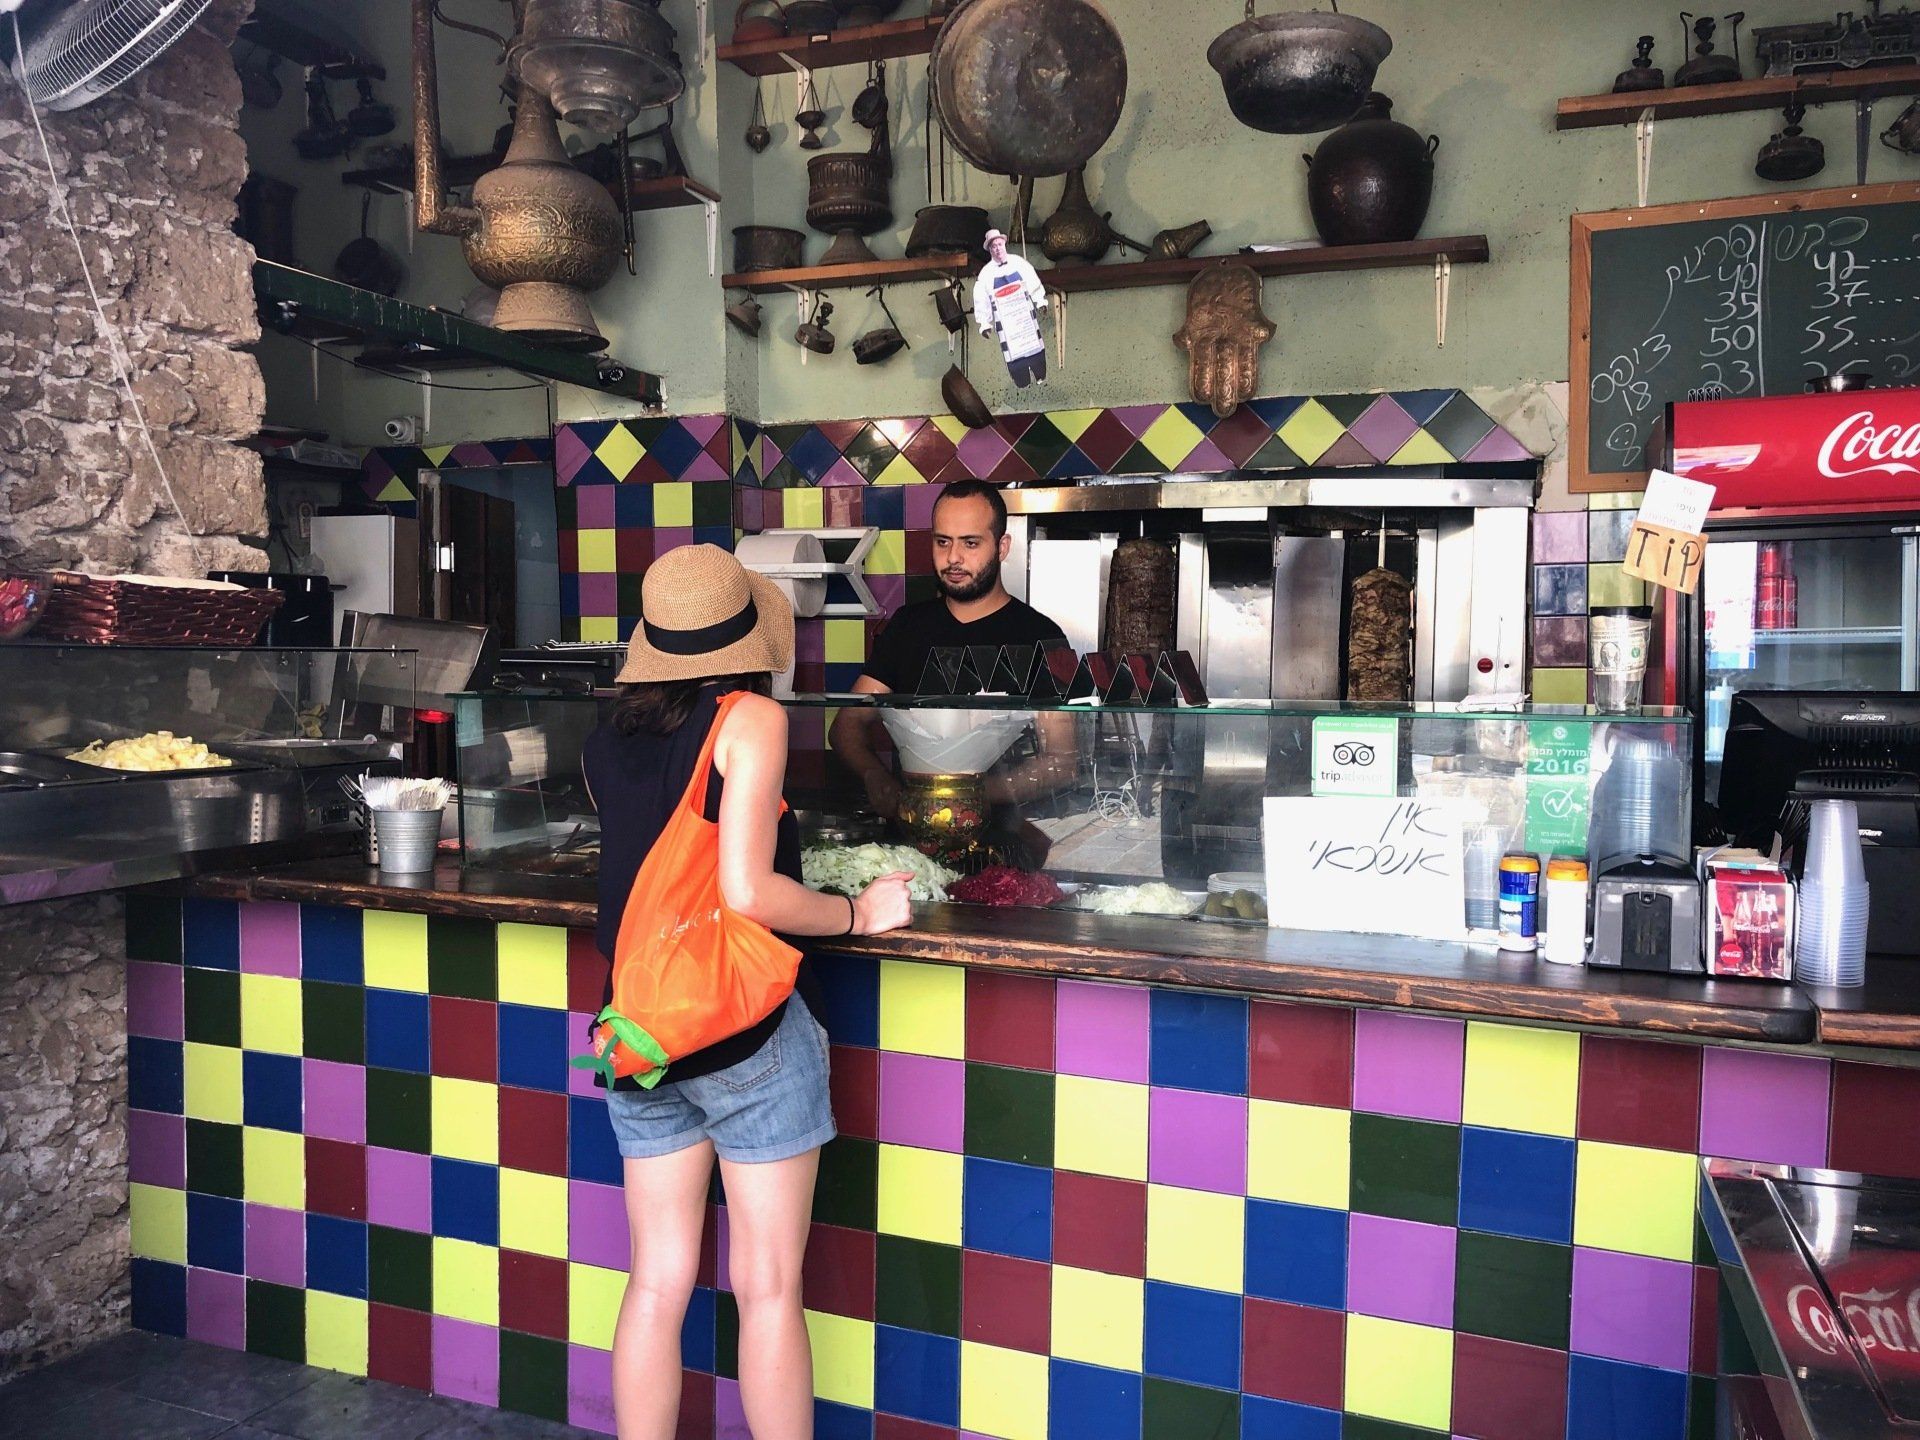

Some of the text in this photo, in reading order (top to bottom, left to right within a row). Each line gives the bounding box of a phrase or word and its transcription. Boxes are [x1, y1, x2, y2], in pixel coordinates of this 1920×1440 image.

[1704, 291, 1760, 322] 35
[1811, 279, 1870, 308] 37
[1699, 324, 1756, 357] 50
[1700, 360, 1755, 395] 23
[1532, 758, 1587, 774] 2016
[1379, 802, 1448, 843] אין
